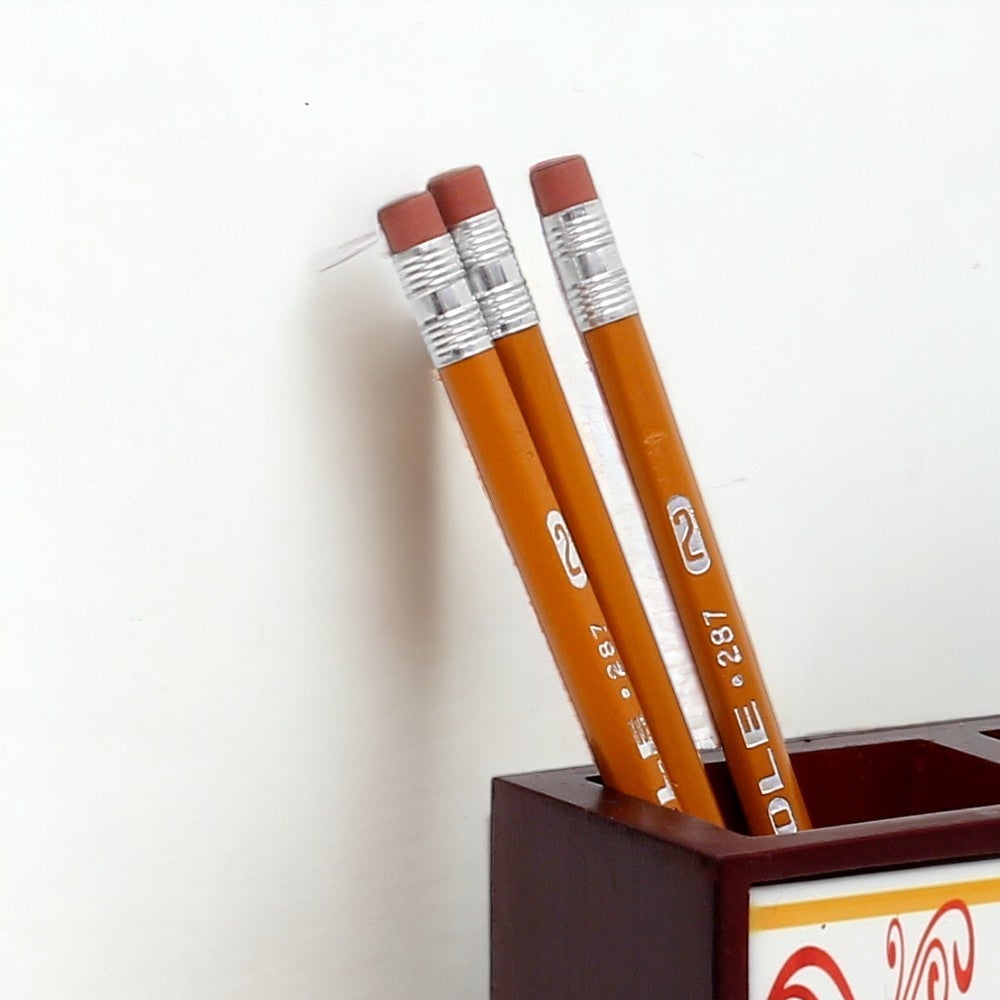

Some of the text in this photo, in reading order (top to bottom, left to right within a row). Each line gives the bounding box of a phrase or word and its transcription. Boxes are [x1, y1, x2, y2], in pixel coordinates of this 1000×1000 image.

[553, 522, 583, 577] 2
[670, 506, 706, 563] 2
[702, 610, 797, 835] DLE 287
